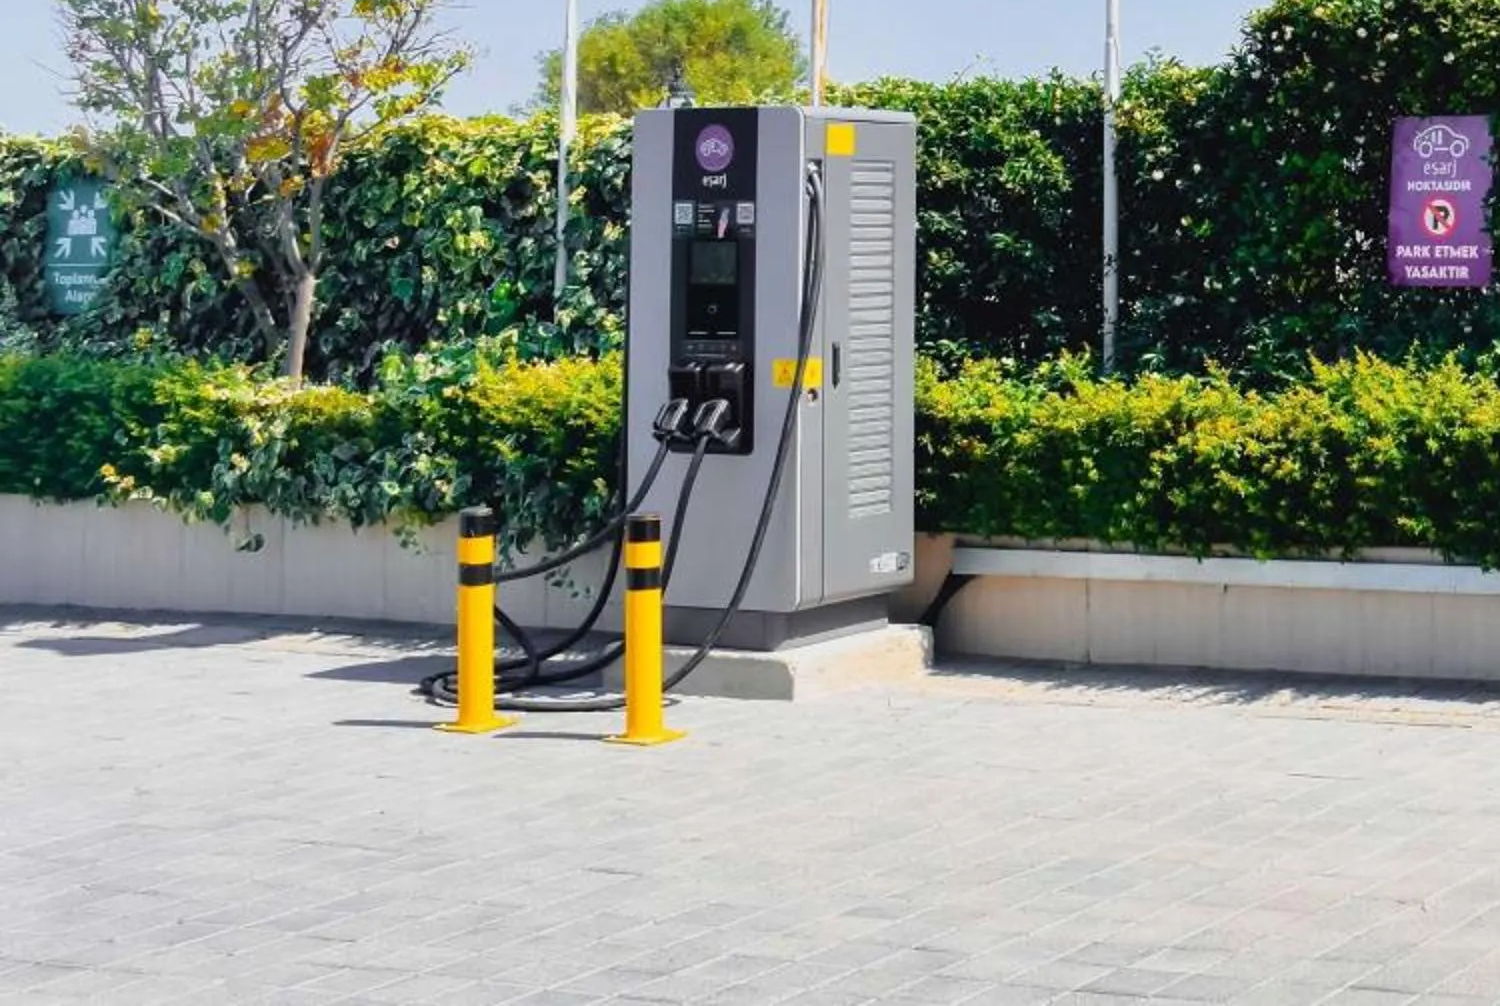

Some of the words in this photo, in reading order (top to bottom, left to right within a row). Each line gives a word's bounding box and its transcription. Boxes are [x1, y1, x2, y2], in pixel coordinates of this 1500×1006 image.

[1396, 245, 1431, 259] PARK
[1434, 245, 1479, 259] ETMEK
[1404, 265, 1470, 279] YASAKTIR
